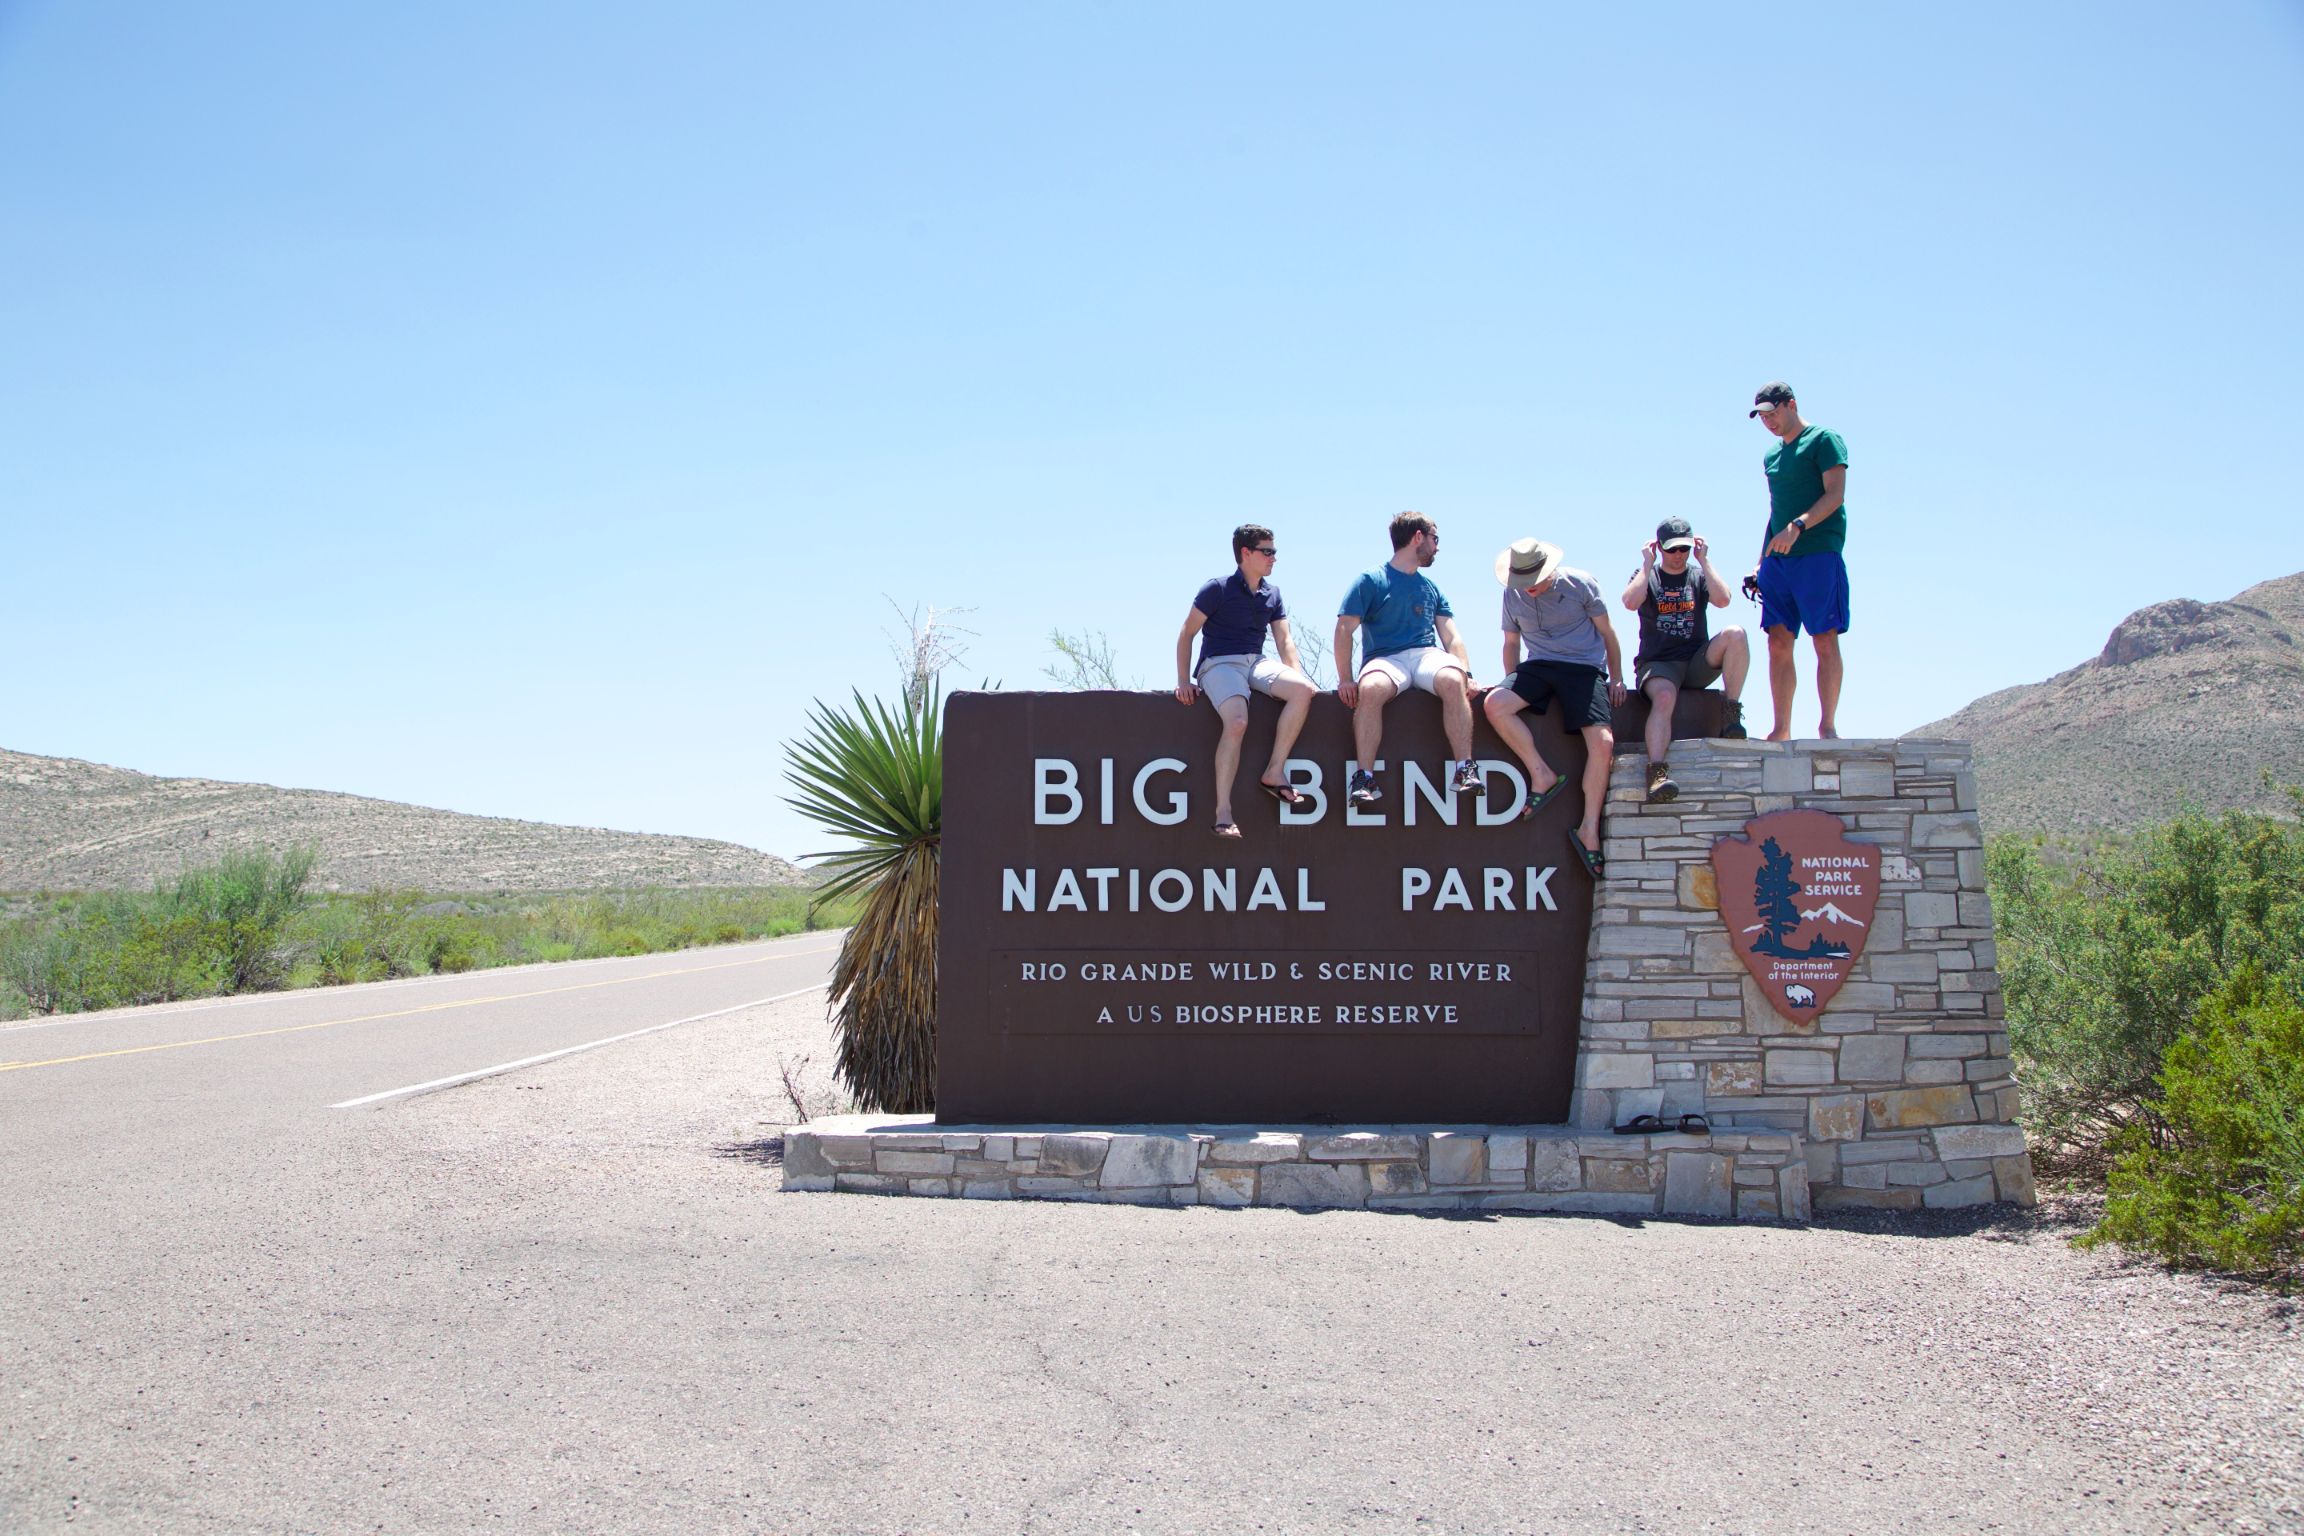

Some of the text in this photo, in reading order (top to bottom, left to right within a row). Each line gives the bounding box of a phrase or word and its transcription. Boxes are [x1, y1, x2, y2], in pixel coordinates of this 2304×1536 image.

[1034, 758, 1528, 826] BIG BEND
[1801, 856, 1870, 868] NATIONAL
[1815, 870, 1852, 882] PARK
[1002, 866, 1558, 913] NATIONAL PARK
[1804, 884, 1863, 896] SERVICE
[1021, 962, 1513, 982] RIO GRANDE WILD & SCENIC RIVER
[1773, 961, 1833, 973] Department
[1767, 971, 1840, 980] of the Interior
[1096, 1004, 1459, 1024] A US BIOSPHERE RESERVE
